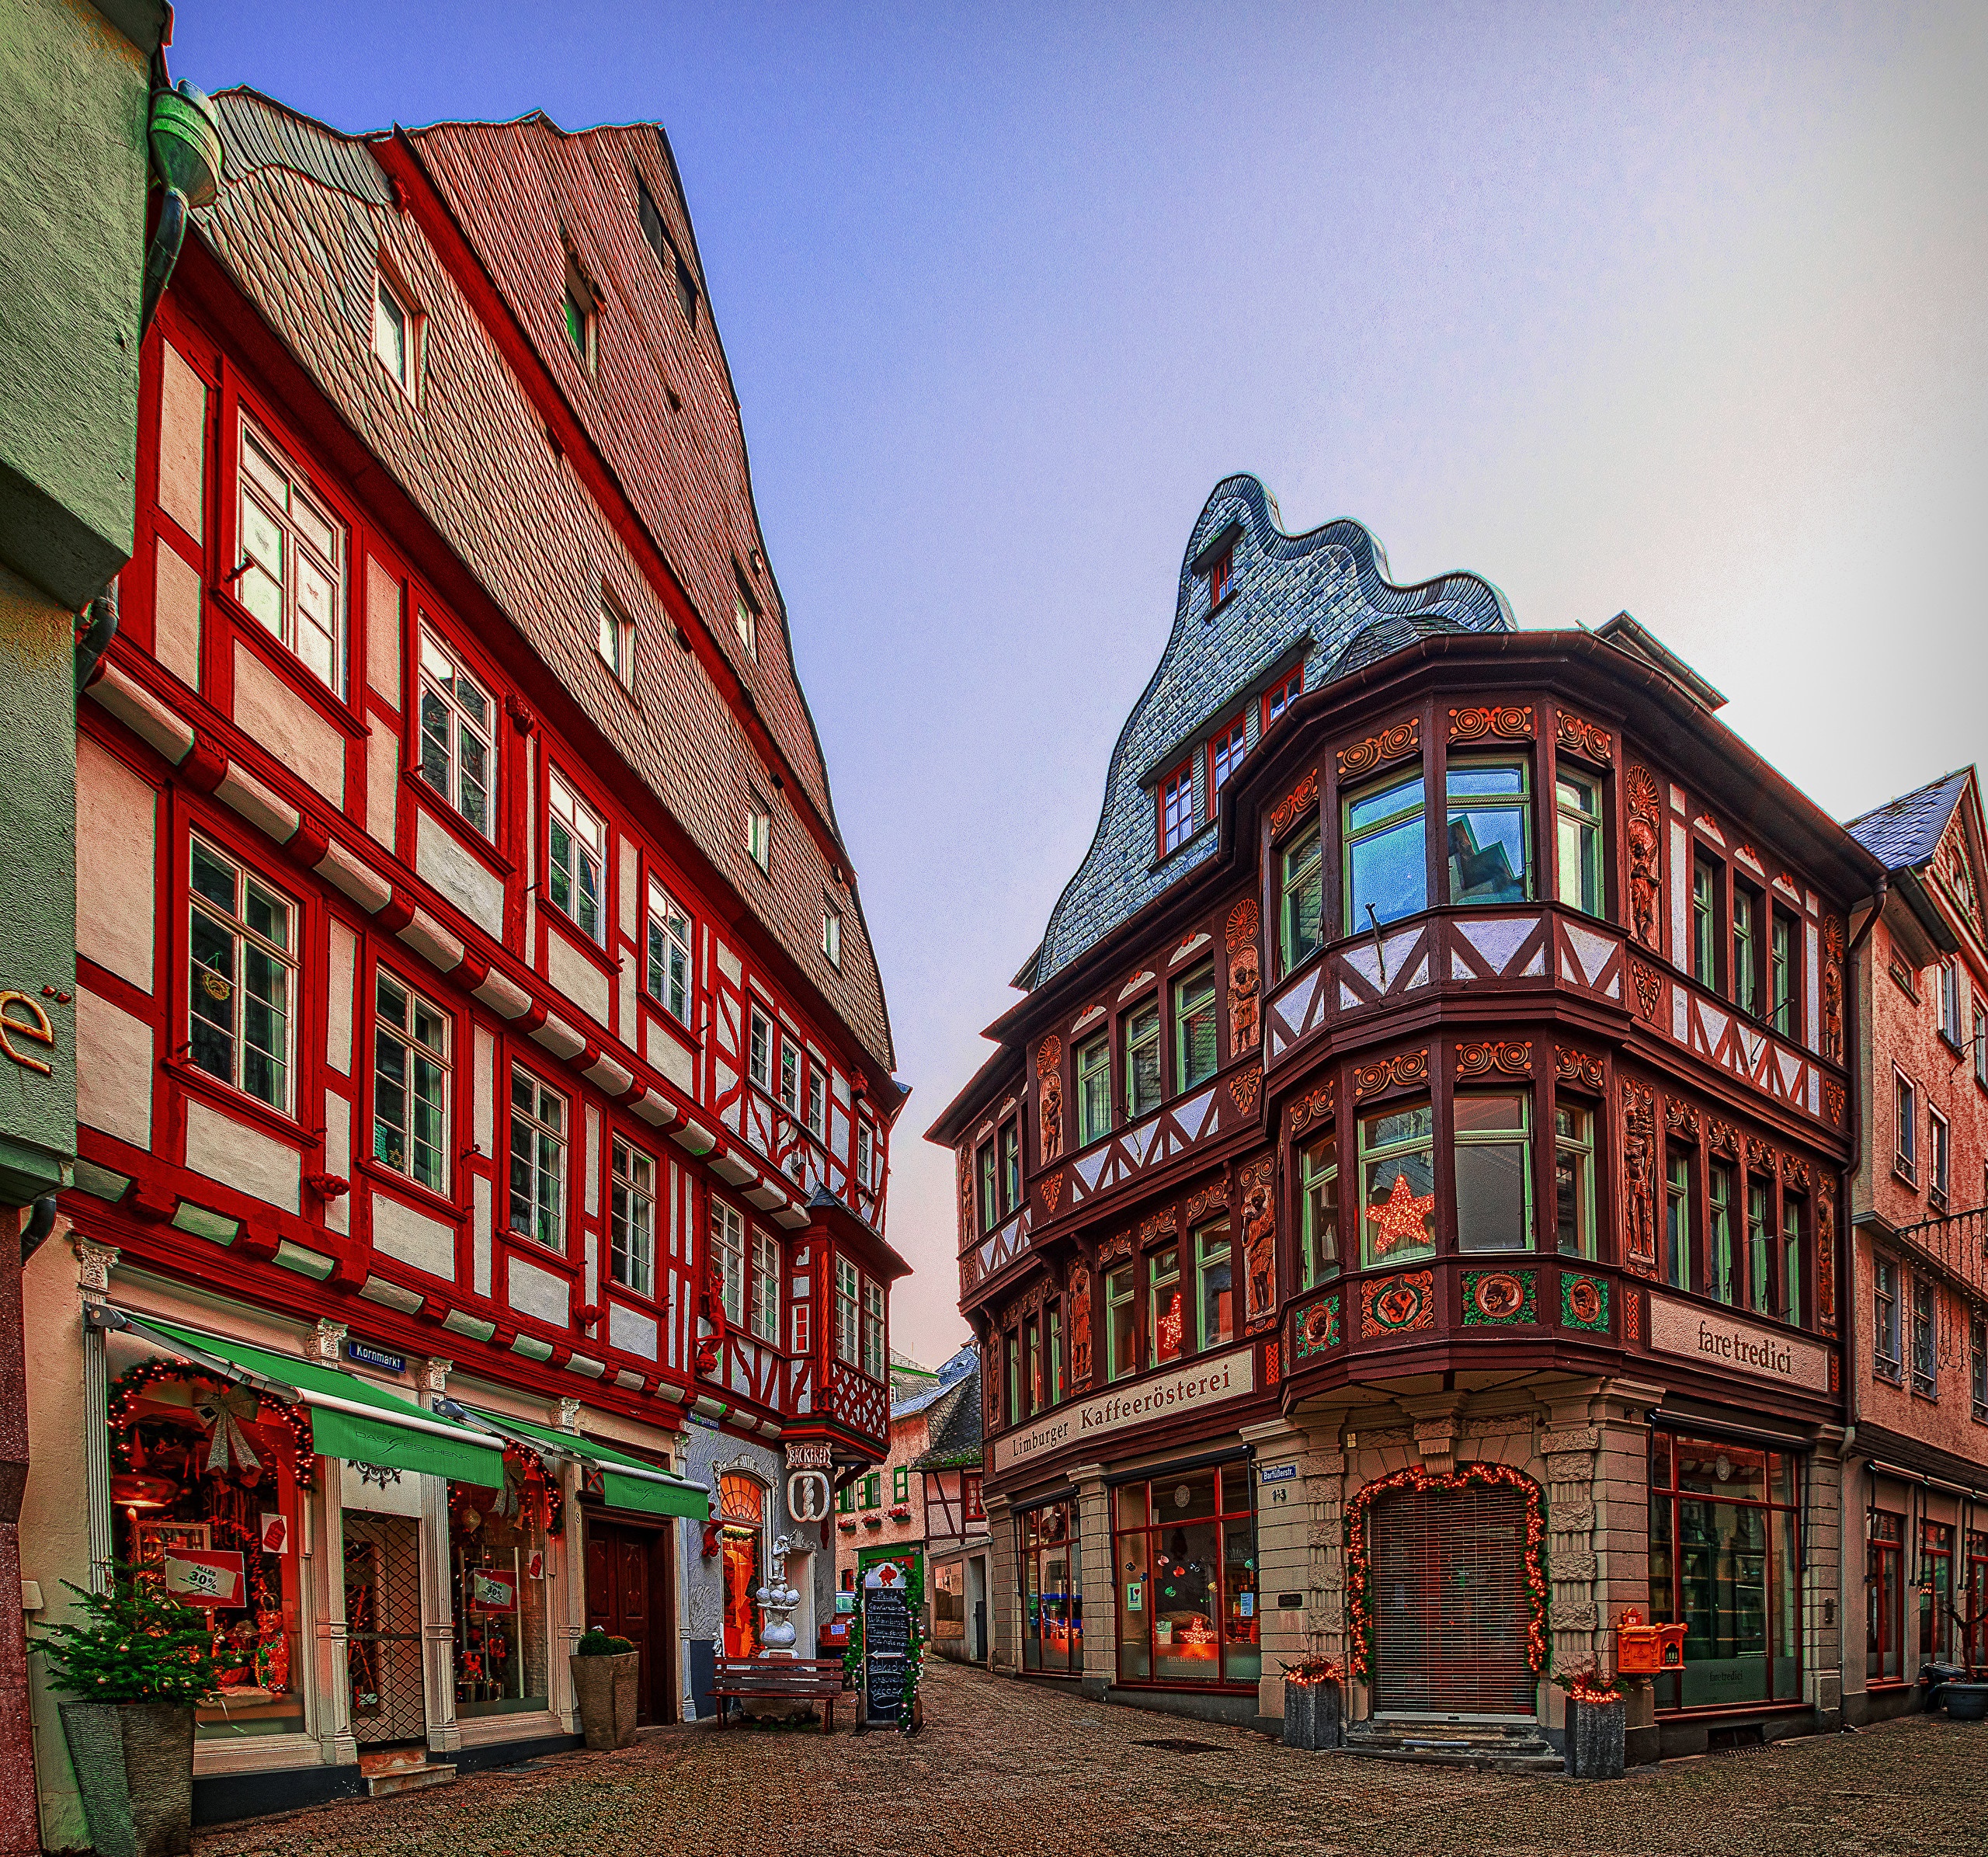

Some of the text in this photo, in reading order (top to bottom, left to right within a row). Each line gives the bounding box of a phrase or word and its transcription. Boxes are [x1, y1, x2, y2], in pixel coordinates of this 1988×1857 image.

[356, 1344, 401, 1368] Kornmarkt
[1013, 1364, 1231, 1457] Limburger Kaffeerösterei
[356, 1431, 471, 1462] DAS GESCHENK
[788, 1447, 827, 1464] BÄCKEREI
[1263, 1467, 1294, 1480] Barfüßerstr.
[575, 1511, 581, 1525] 8
[195, 1564, 217, 1577] ALLES
[187, 1570, 217, 1590] 30%
[486, 1585, 503, 1600] 30%
